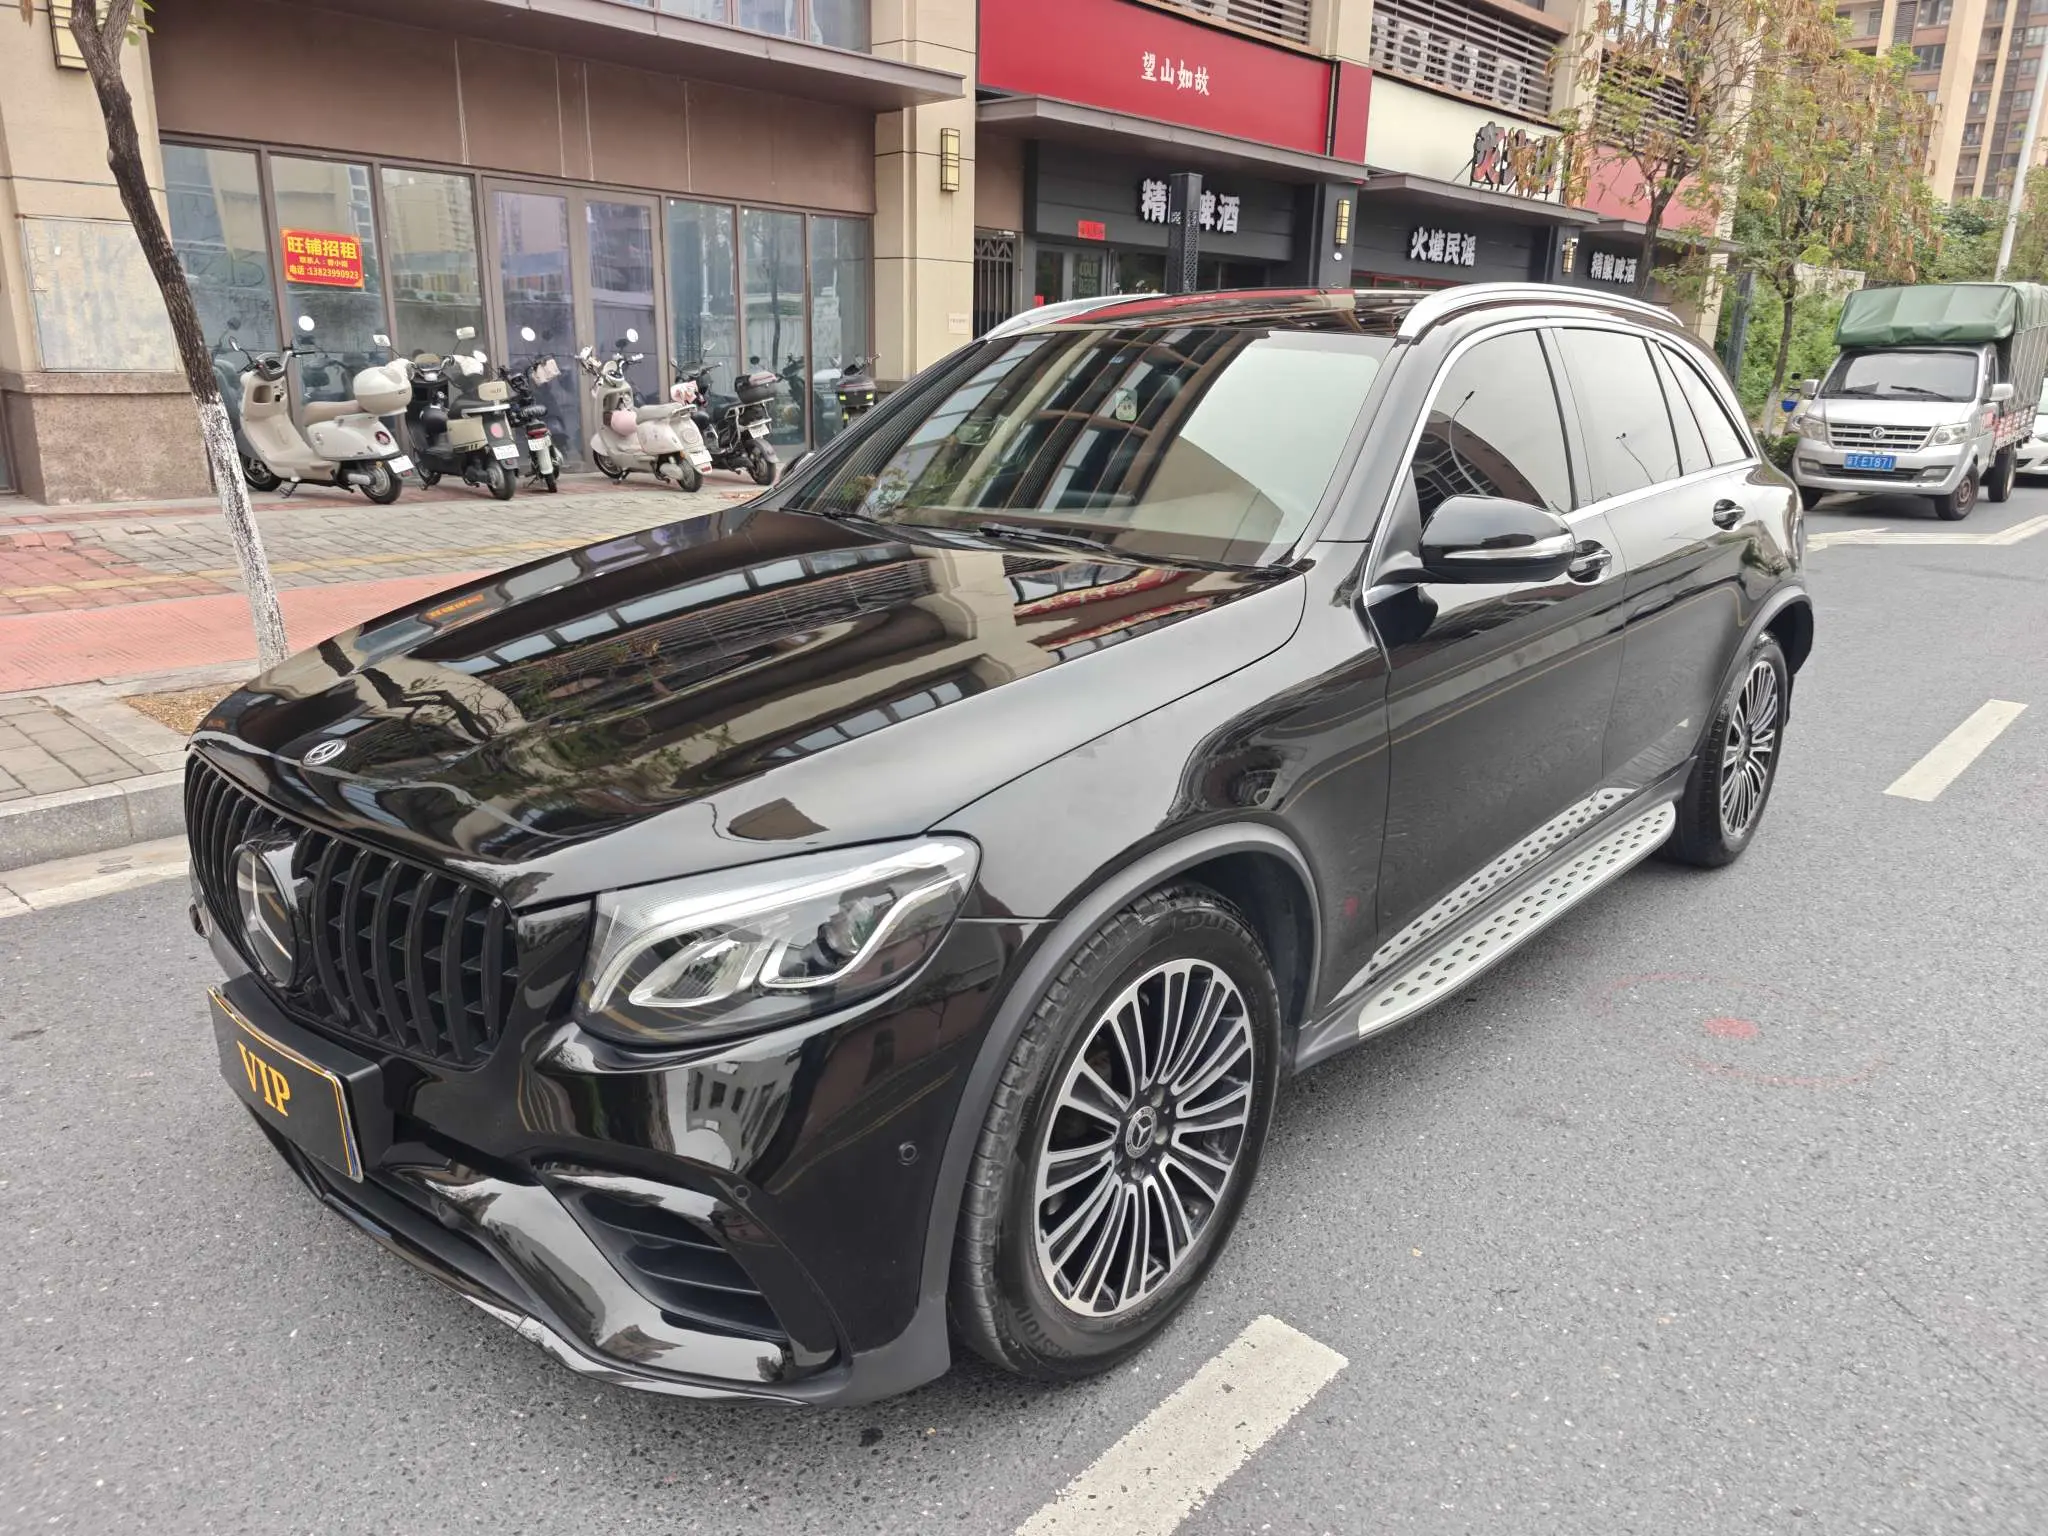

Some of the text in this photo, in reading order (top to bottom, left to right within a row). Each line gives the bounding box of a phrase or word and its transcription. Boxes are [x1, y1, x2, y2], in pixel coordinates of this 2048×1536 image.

[1141, 51, 1209, 95] 望山如故
[1141, 178, 1240, 233] 精啤酒
[287, 236, 357, 259] 旺铺招租
[1411, 226, 1477, 267] 火塘民谣
[236, 1040, 291, 1117] VIP
